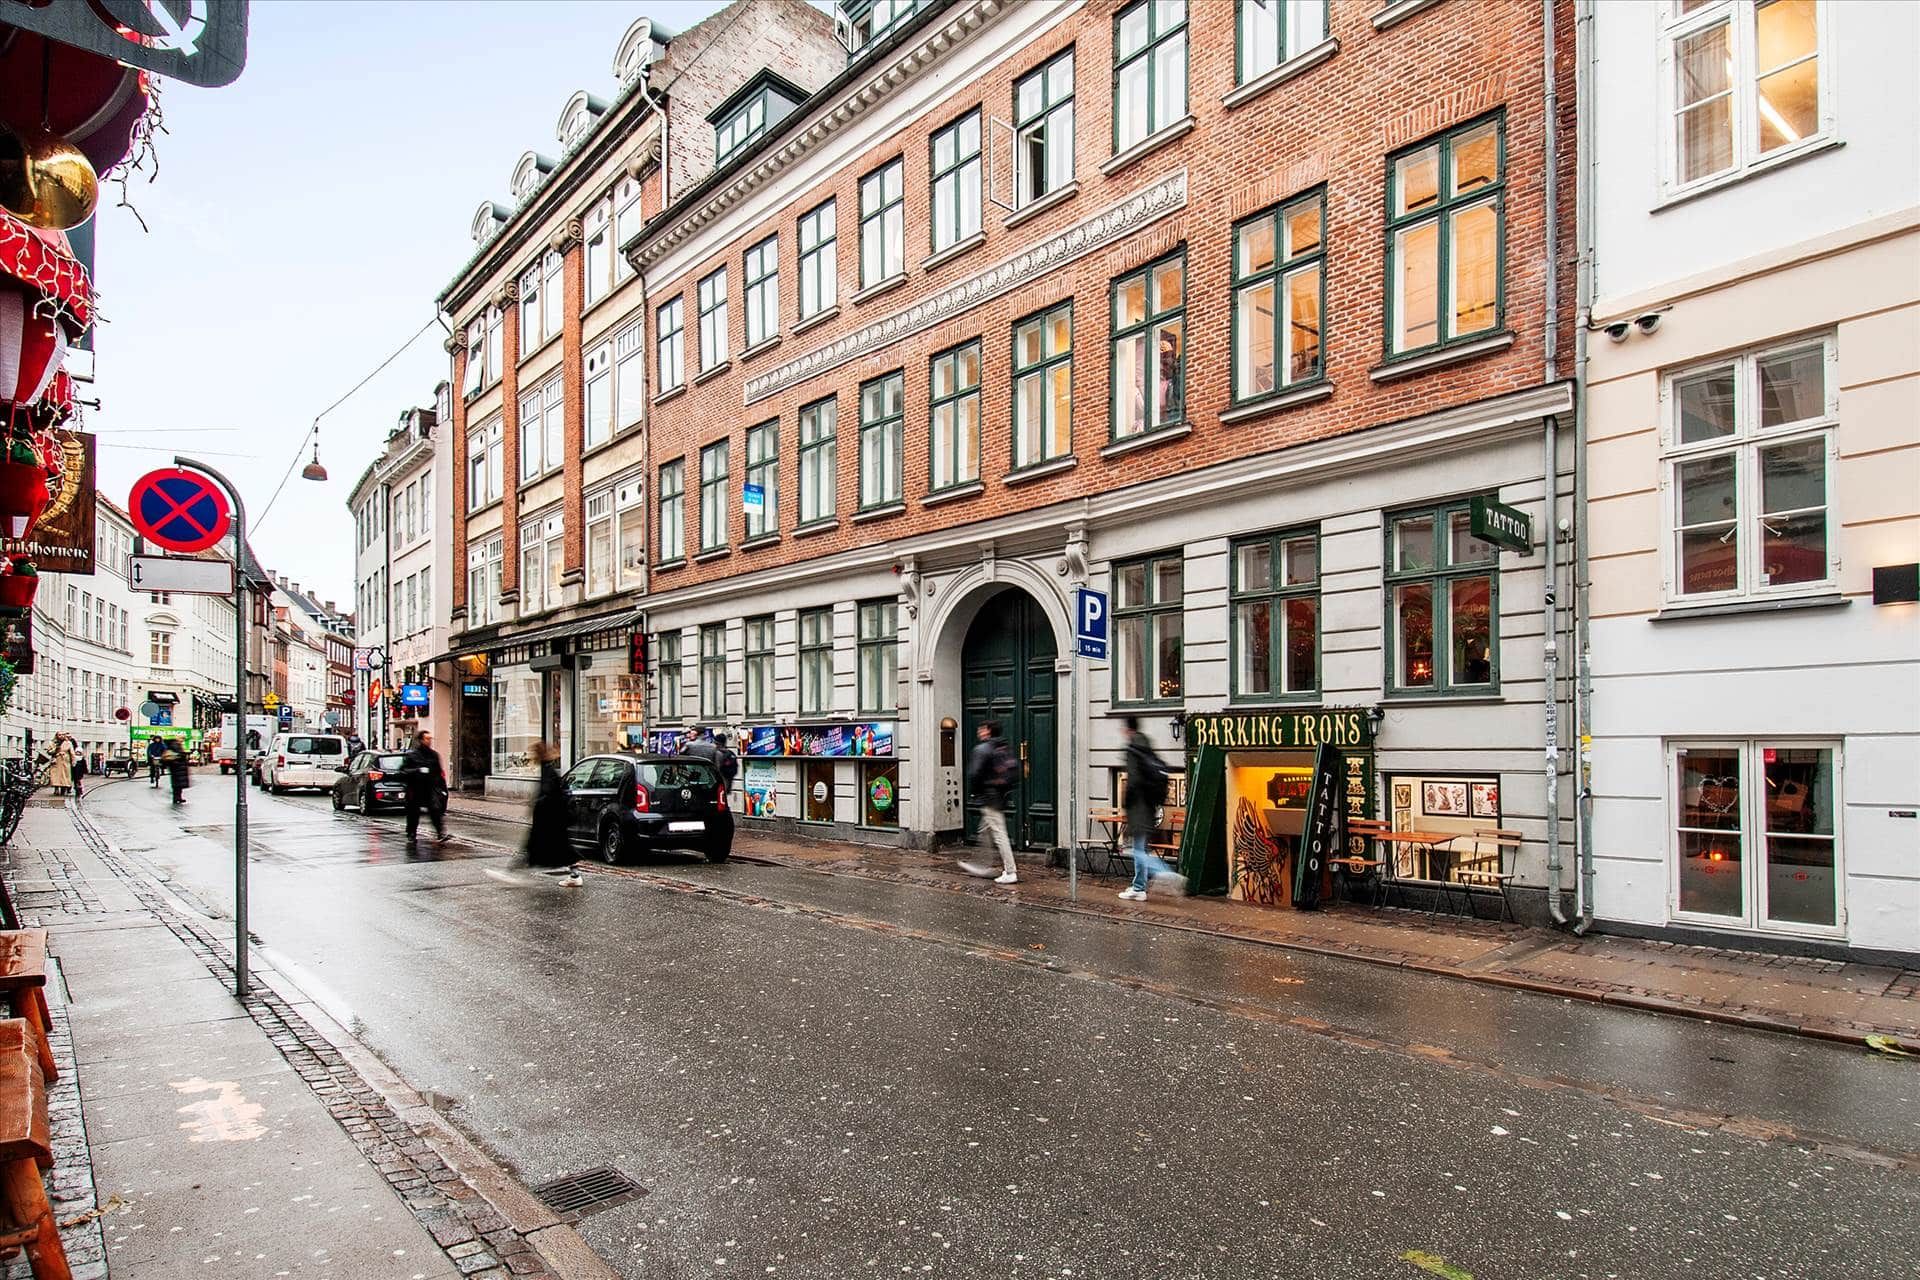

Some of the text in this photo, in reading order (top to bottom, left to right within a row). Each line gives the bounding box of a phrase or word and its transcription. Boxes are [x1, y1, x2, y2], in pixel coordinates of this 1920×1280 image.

[1486, 507, 1526, 540] TATTOO
[1085, 594, 1102, 632] P
[634, 633, 644, 673] BAR
[1085, 644, 1102, 654] 15 min
[282, 706, 290, 716] P
[1194, 713, 1361, 747] BARKING IRONS
[1309, 772, 1332, 871] TATTOO
